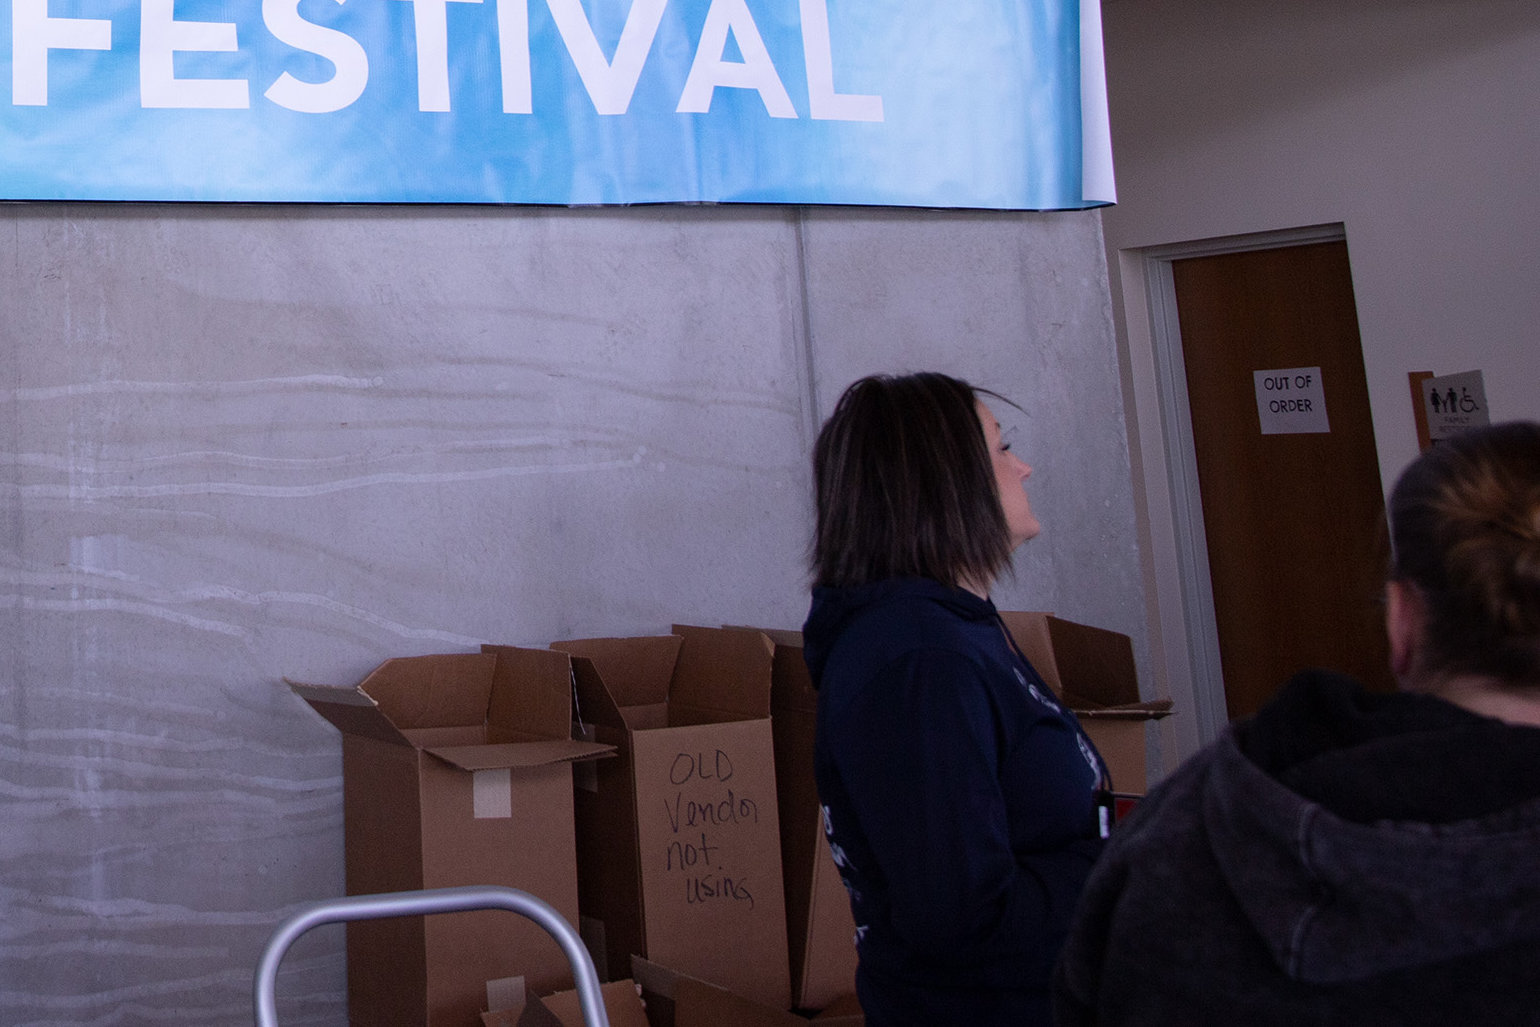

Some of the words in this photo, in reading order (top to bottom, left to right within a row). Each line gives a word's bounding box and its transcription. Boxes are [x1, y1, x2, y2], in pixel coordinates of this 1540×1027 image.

[1264, 377, 1289, 391] OUT
[1295, 375, 1312, 390] OF
[1269, 399, 1313, 414] ORDER
[670, 749, 734, 785] OLD
